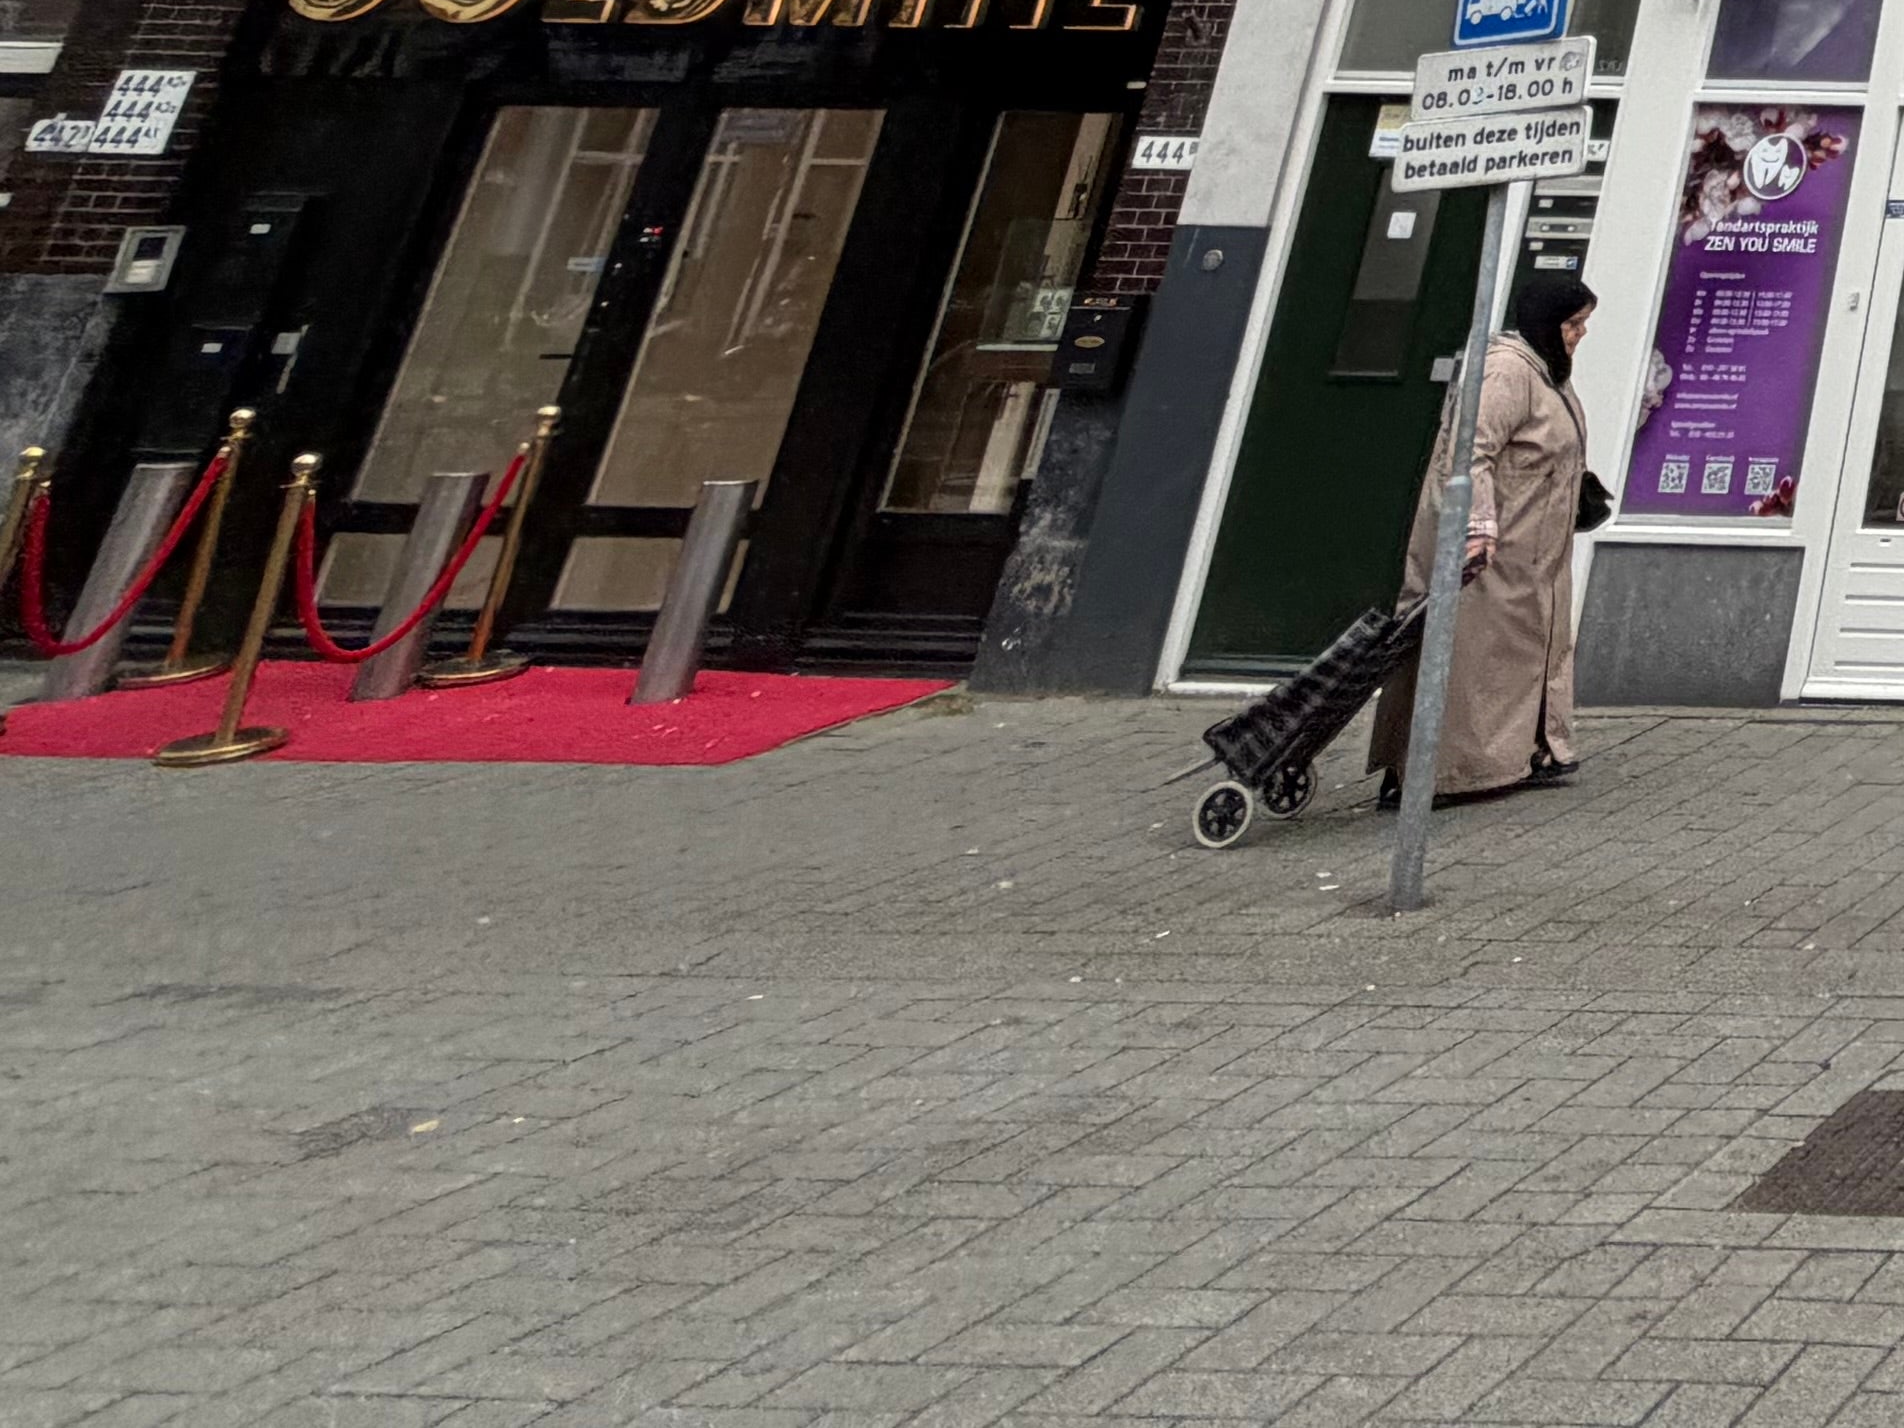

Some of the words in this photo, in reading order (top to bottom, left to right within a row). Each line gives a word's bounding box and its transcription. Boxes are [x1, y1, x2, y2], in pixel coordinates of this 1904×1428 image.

[1448, 66, 1477, 83] ma
[1486, 57, 1525, 79] t/m
[1535, 57, 1556, 72] vr
[1562, 77, 1573, 95] h
[1402, 132, 1467, 153] buiten
[1473, 127, 1518, 145] deze
[1525, 121, 1581, 145] tijden
[1404, 155, 1478, 180] betaald
[1485, 149, 1573, 175] parkeren
[1710, 219, 1819, 237] Tandartspraktijk
[1704, 235, 1735, 251] ZEN
[1740, 237, 1769, 252] YOU
[1772, 238, 1817, 253] SMILE
